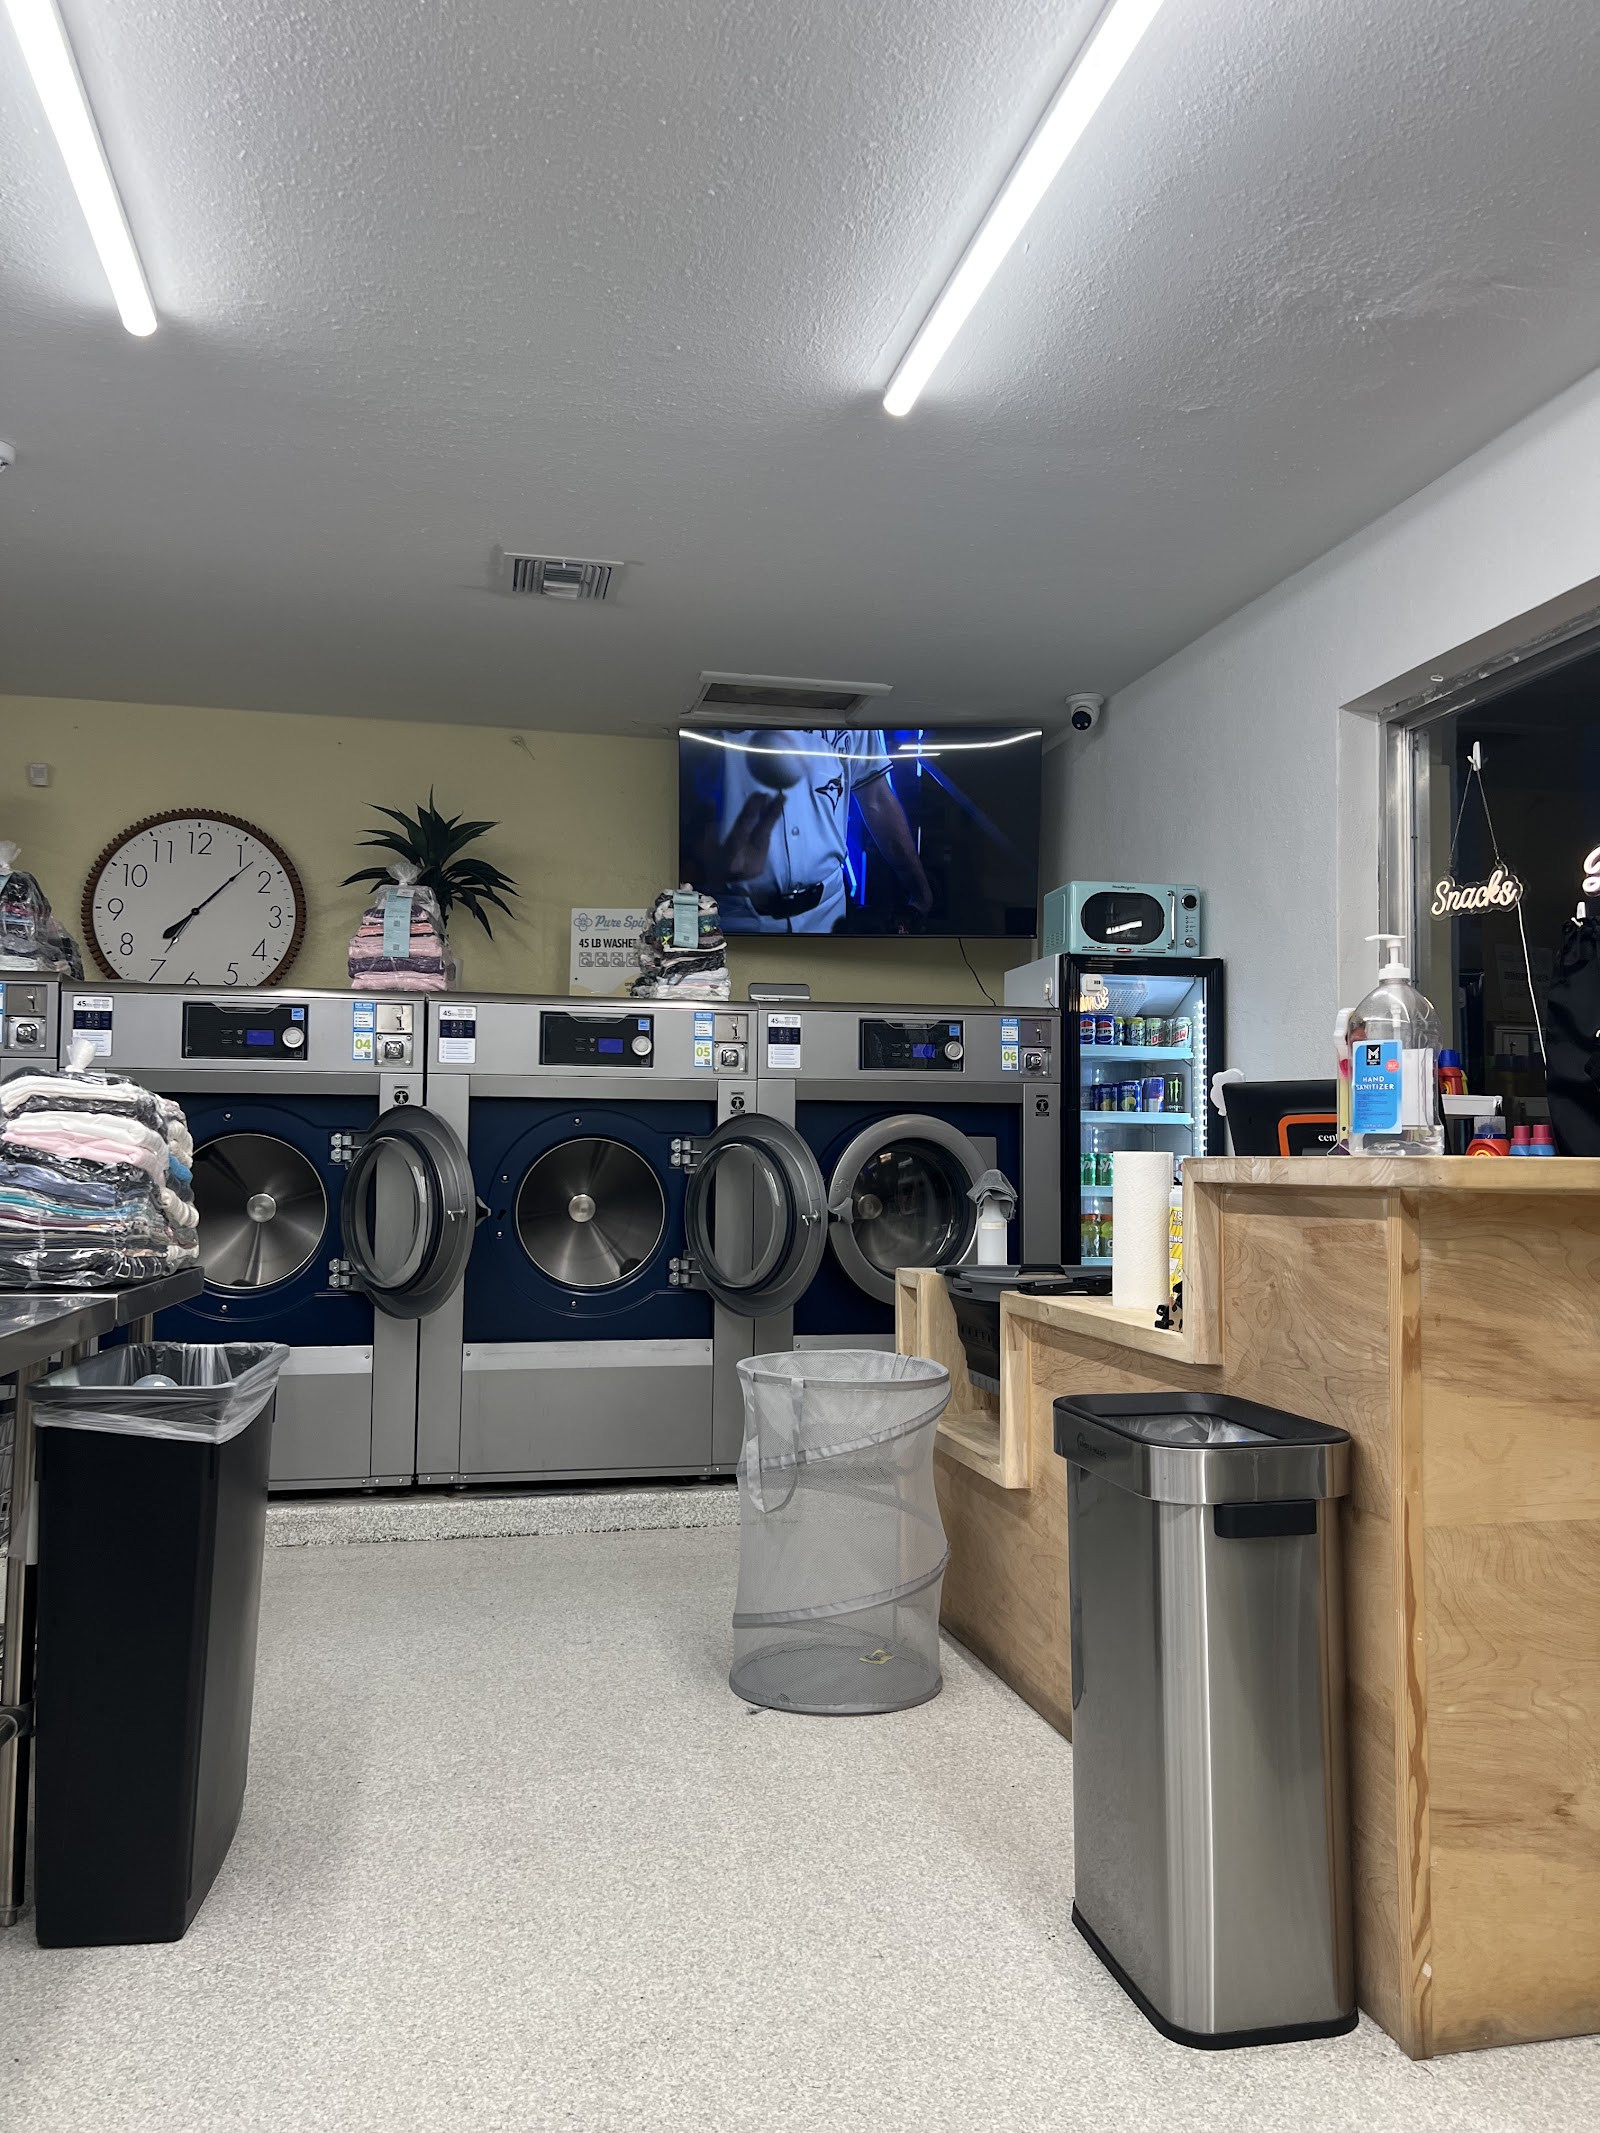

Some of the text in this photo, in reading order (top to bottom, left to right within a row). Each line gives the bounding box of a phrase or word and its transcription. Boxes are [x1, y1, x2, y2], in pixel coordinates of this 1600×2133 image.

[152, 839, 173, 863] 11
[188, 831, 213, 855] 12
[236, 844, 243, 867] 1
[122, 863, 148, 887] 10
[257, 870, 272, 894] 2
[1430, 869, 1518, 915] Snacks
[107, 898, 124, 921] 9
[268, 905, 282, 929] 3
[594, 915, 622, 928] Pure
[119, 932, 134, 956] 8
[251, 938, 267, 961] 4
[578, 938, 637, 948] 45 LB WASHE
[148, 958, 167, 982] 7
[223, 962, 239, 986] 5
[355, 1038, 372, 1050] 04
[696, 1046, 711, 1057] 05
[1003, 1051, 1017, 1062] 06
[1355, 1083, 1395, 1091] SANITIZER
